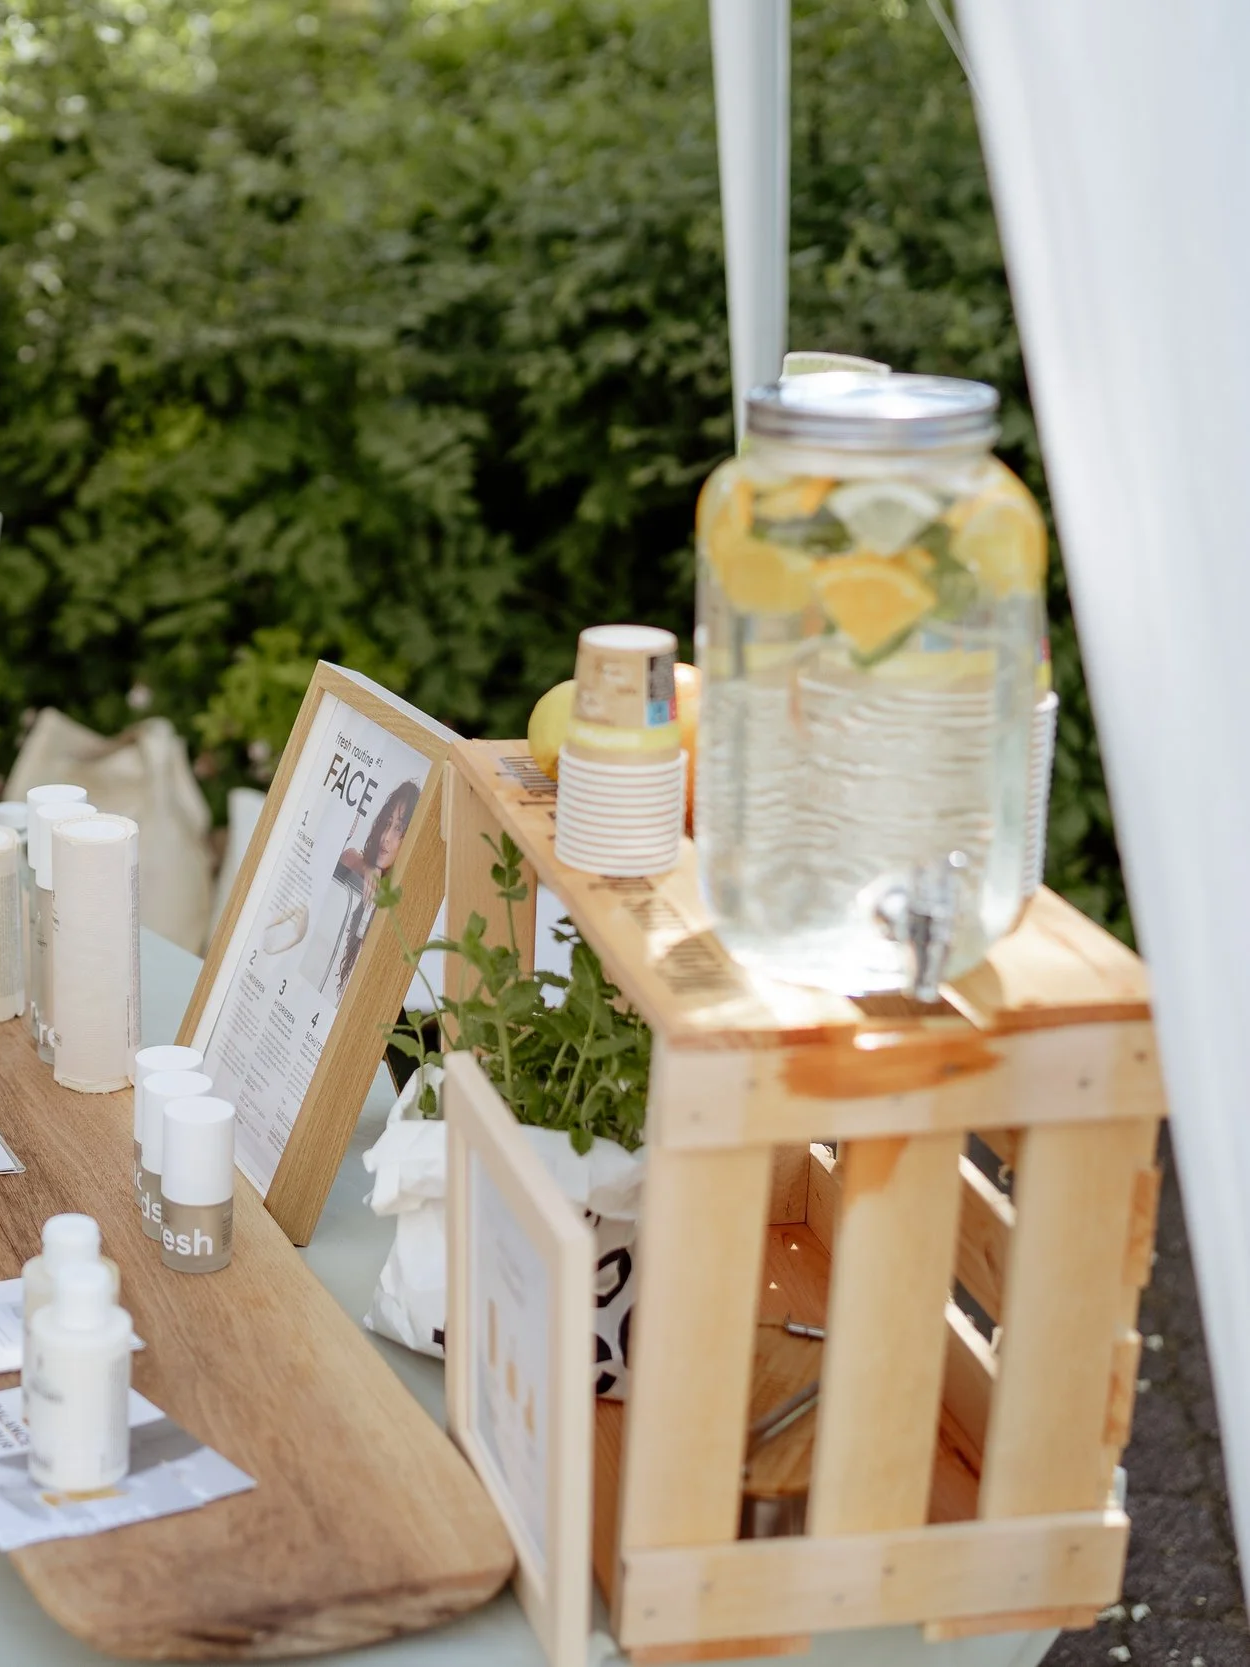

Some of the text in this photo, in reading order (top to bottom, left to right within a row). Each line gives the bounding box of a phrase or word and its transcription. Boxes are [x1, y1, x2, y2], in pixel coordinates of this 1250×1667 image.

[335, 731, 352, 753] fresh
[351, 746, 374, 768] routine
[323, 753, 379, 818] FACE
[301, 810, 309, 827] 1
[249, 949, 258, 966] 2
[278, 979, 287, 996] 3
[311, 1012, 320, 1029] 4
[304, 1031, 325, 1053] SCHÜTZ
[160, 1225, 213, 1256] esh
